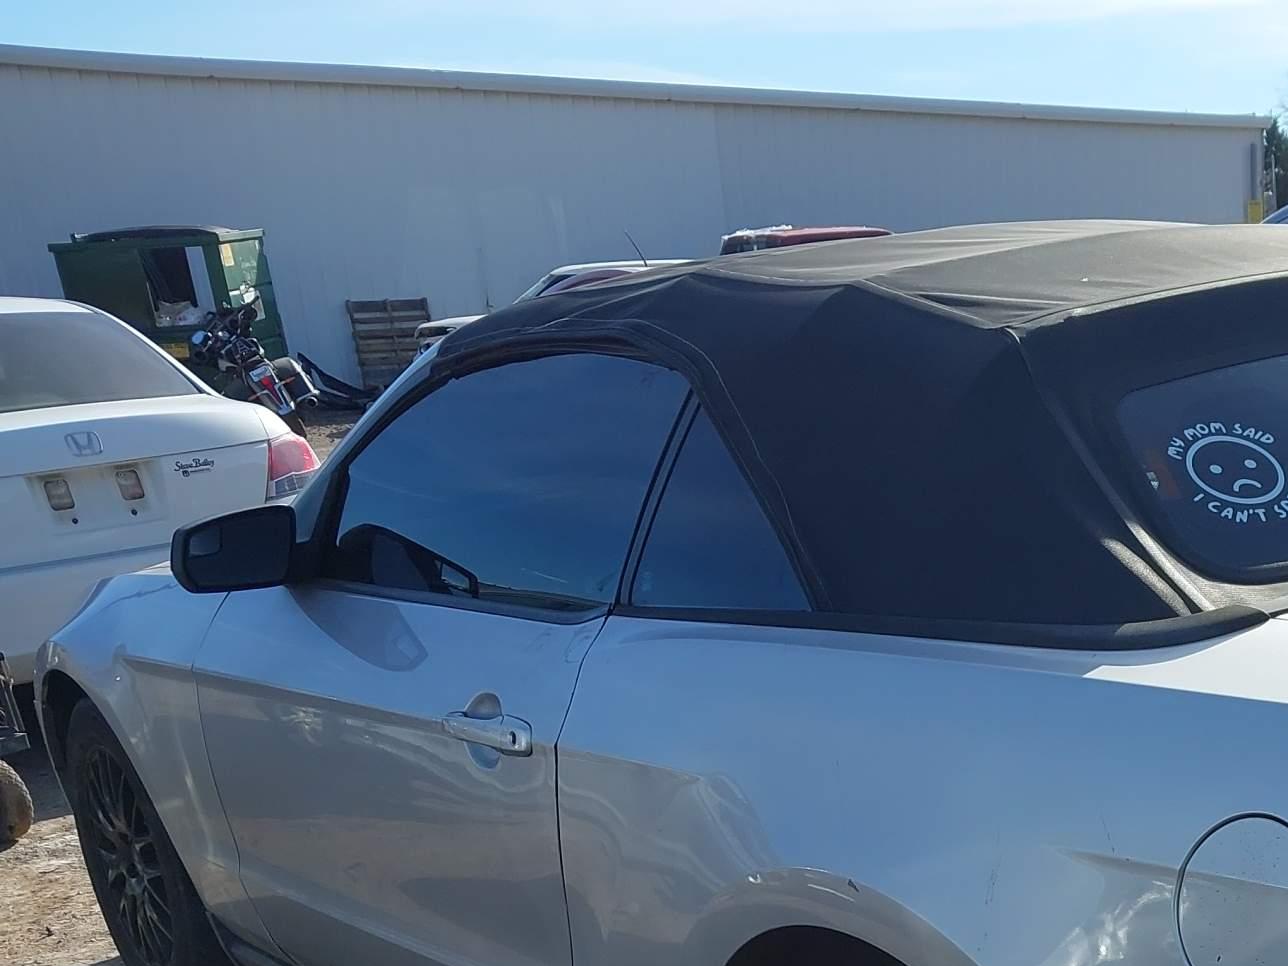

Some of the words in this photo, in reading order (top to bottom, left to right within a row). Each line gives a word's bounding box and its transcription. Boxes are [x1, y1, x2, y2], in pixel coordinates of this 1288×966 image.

[1167, 437, 1185, 460] MY
[1183, 422, 1227, 441] MOM
[1231, 423, 1275, 444] SAID
[1193, 493, 1205, 502] I
[1207, 501, 1267, 523] CAN'T
